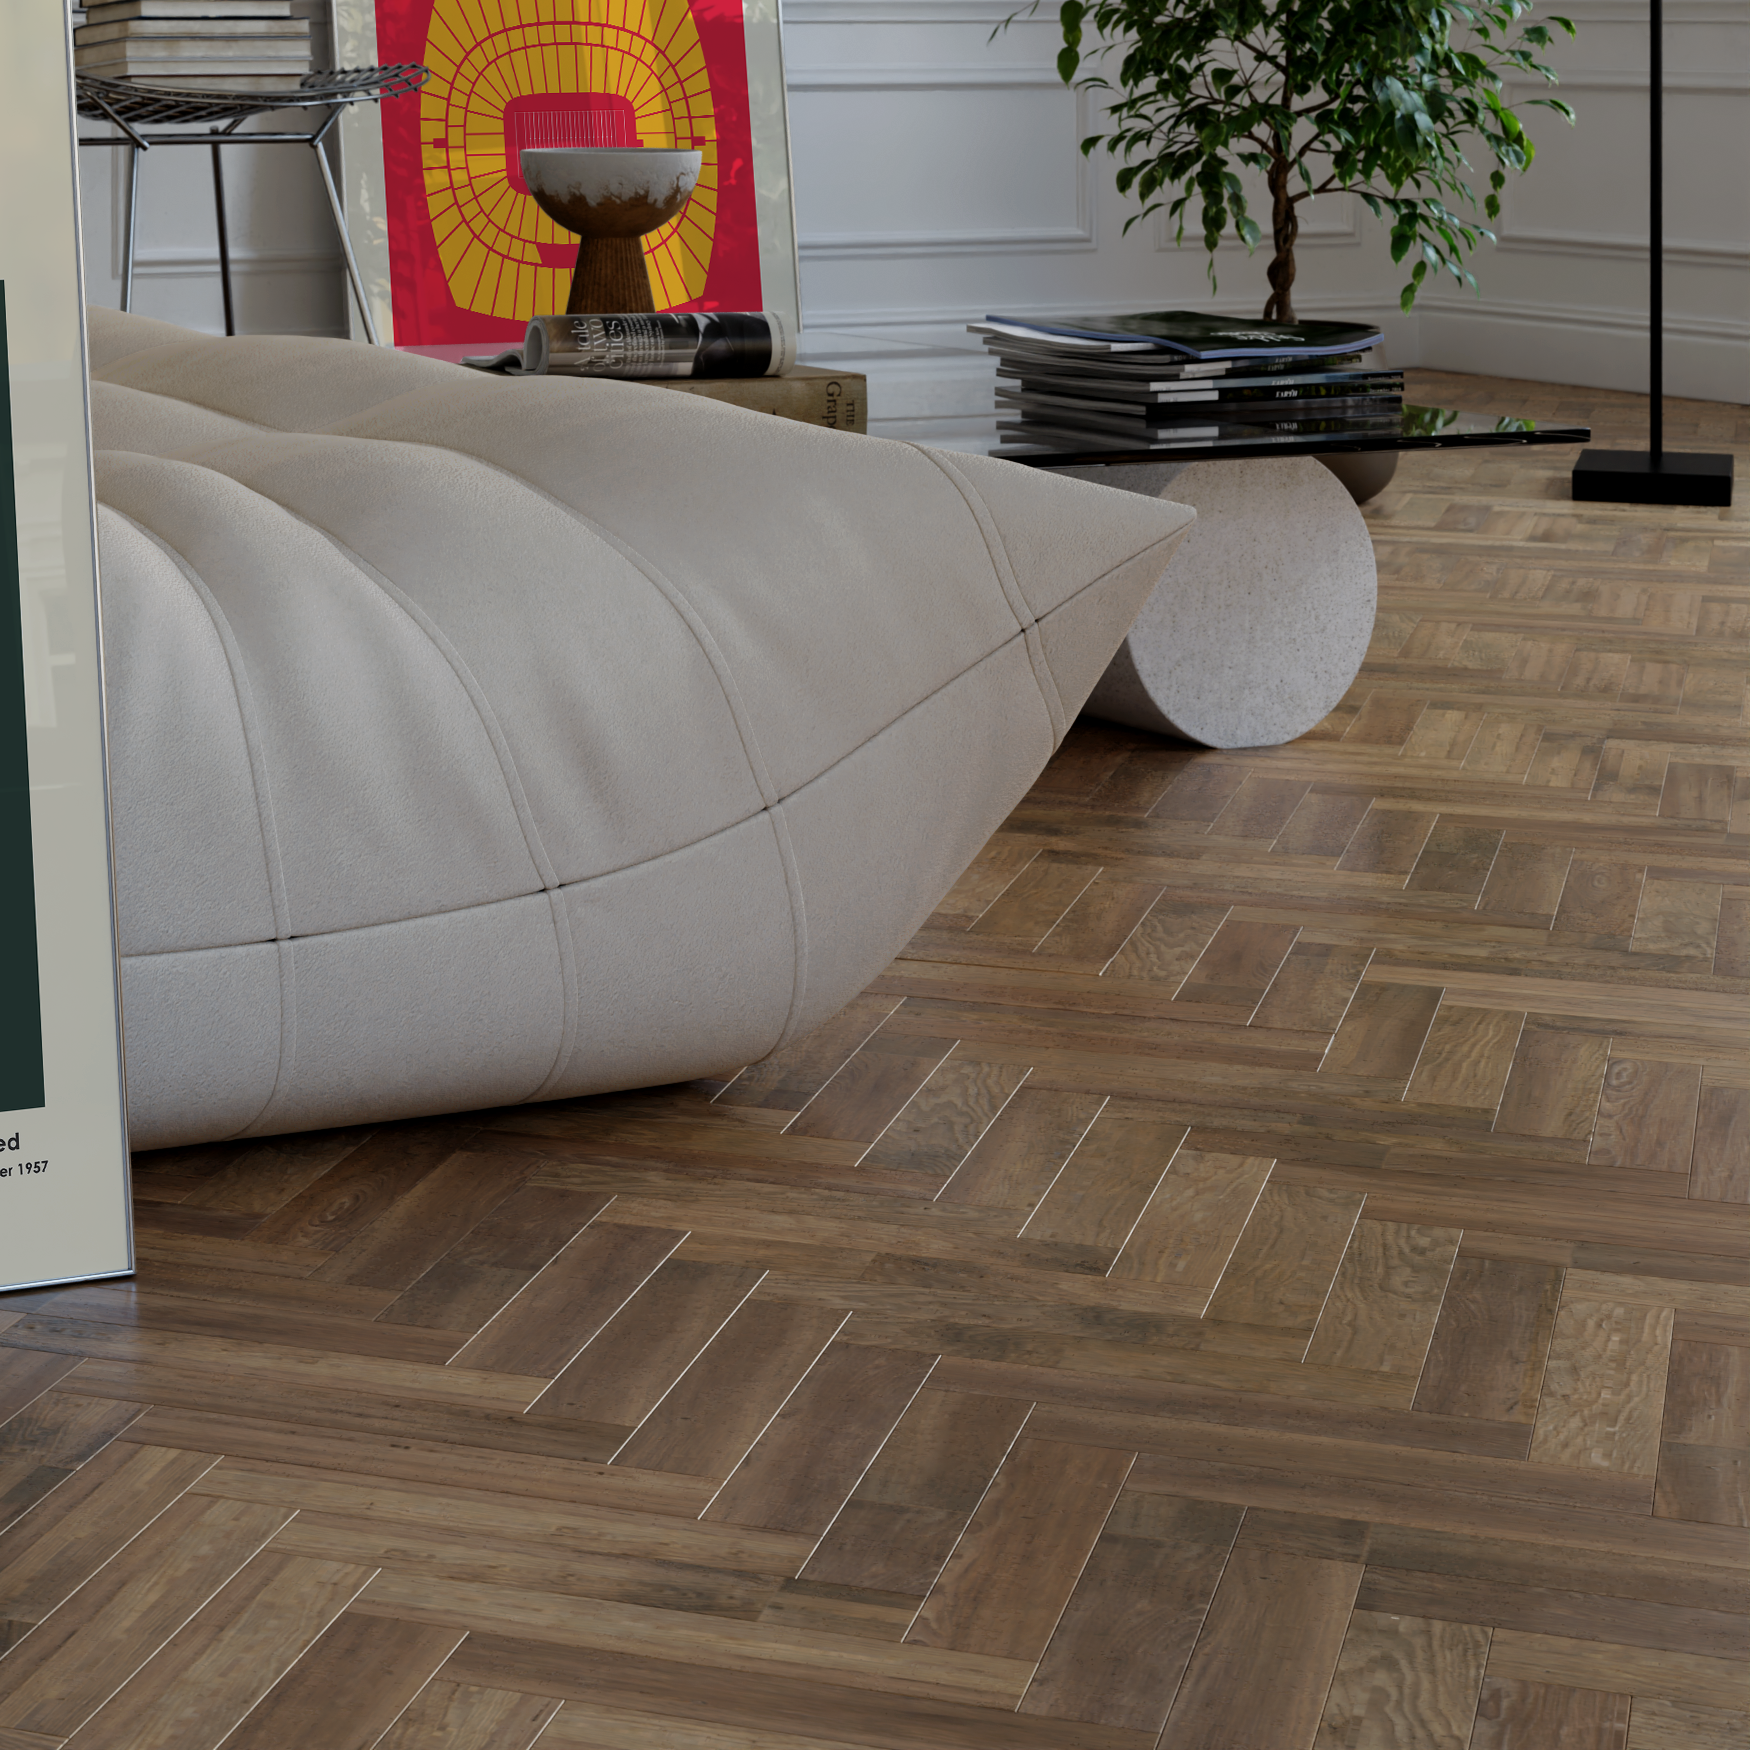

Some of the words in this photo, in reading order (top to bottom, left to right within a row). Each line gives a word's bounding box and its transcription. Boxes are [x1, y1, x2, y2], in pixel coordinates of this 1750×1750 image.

[570, 320, 591, 351] tale
[589, 319, 608, 352] two
[605, 320, 624, 369] cities
[573, 356, 591, 371] A
[591, 356, 608, 372] of
[846, 399, 856, 426] THE
[17, 1160, 49, 1176] 1957
